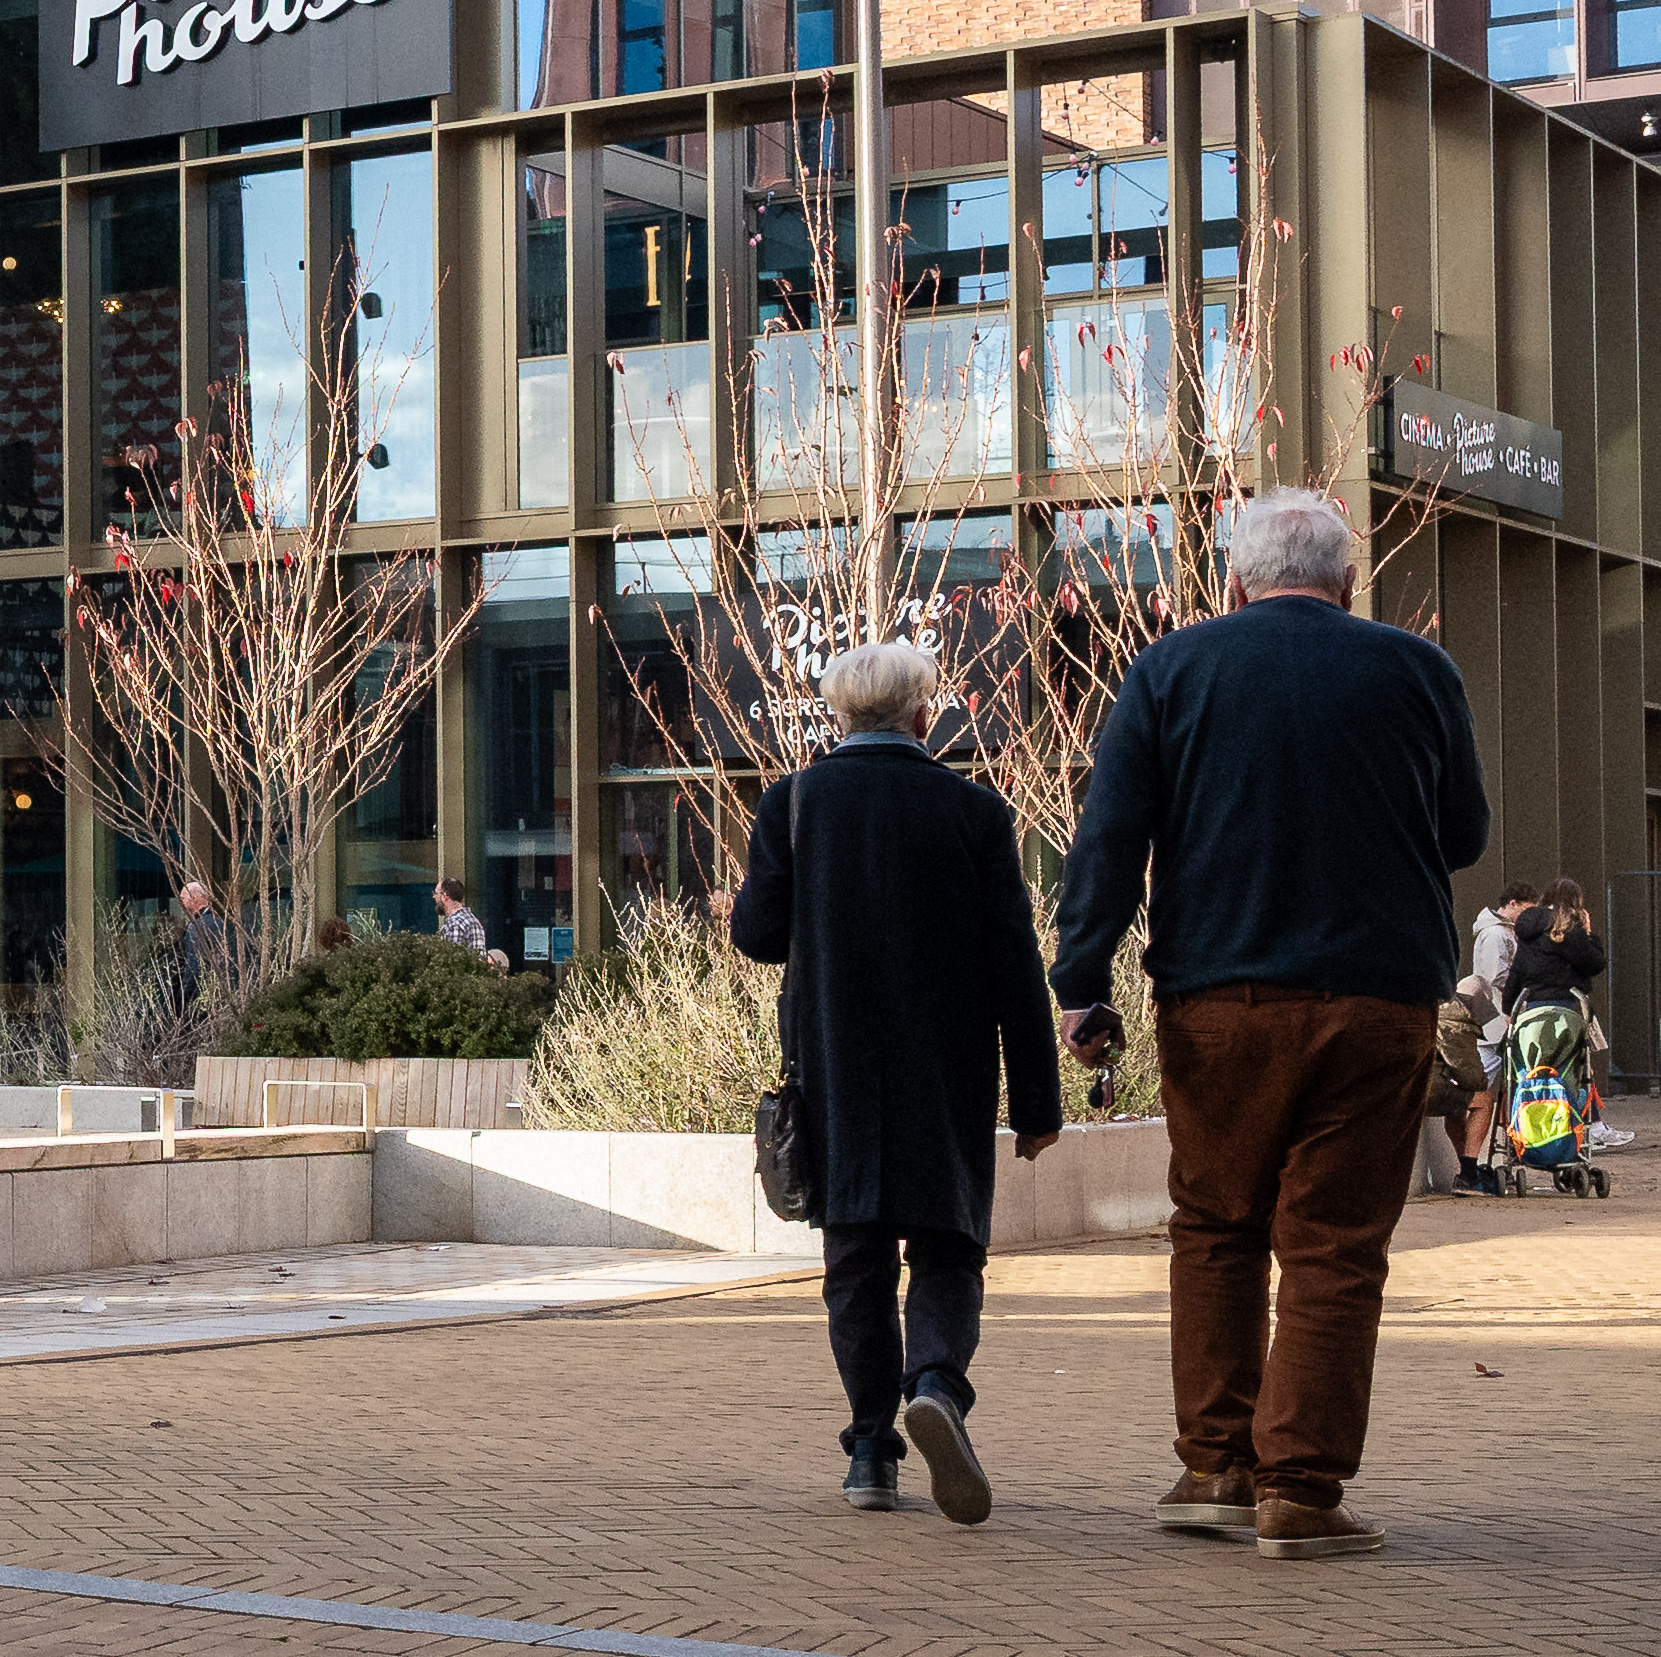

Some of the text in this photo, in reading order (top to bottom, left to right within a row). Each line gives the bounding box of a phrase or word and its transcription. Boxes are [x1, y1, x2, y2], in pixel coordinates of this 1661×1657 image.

[1400, 412, 1561, 487] CINEMA Picture house CAFÉ BAR
[750, 700, 763, 719] 6
